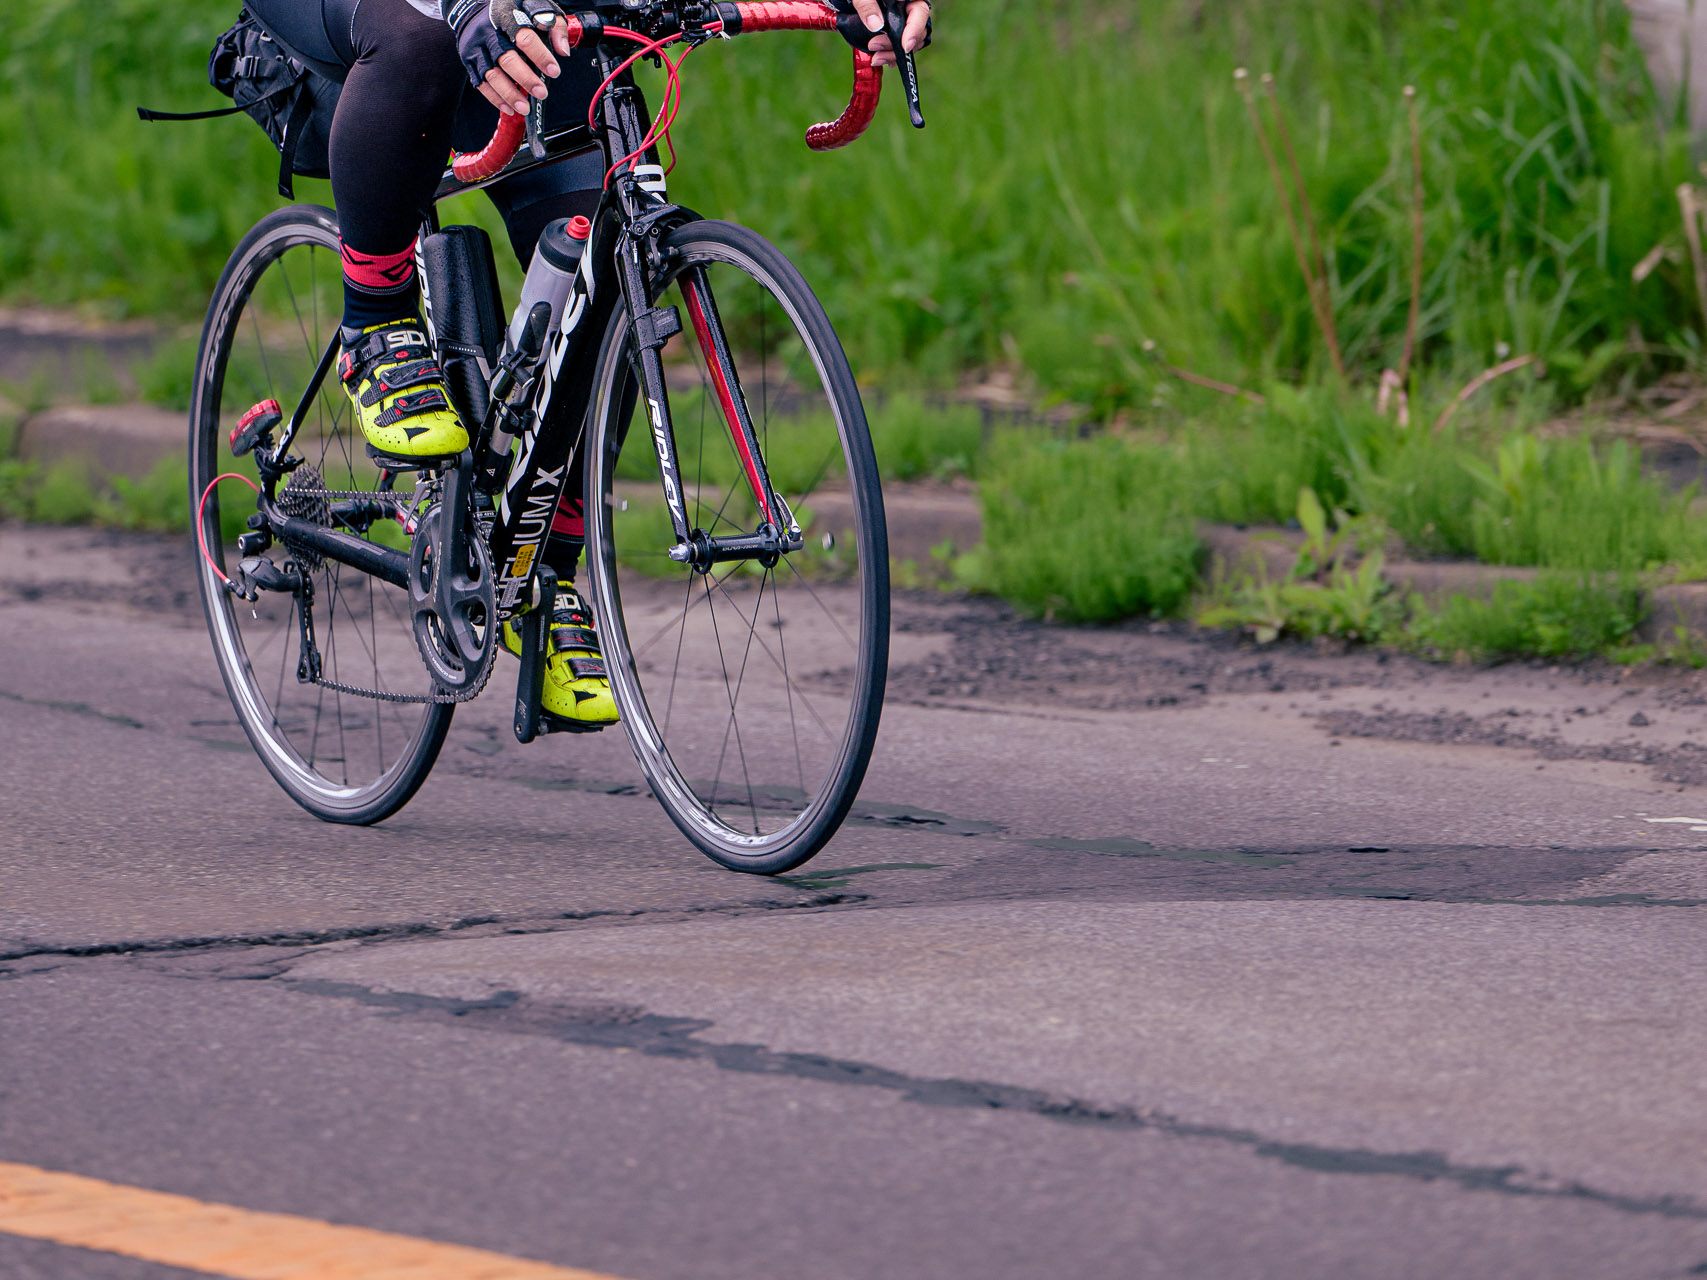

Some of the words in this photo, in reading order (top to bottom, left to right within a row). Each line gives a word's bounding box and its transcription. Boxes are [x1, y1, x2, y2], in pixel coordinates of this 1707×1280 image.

[905, 52, 919, 103] TEGRA
[387, 330, 428, 349] SIDI
[531, 464, 565, 491] X
[648, 397, 683, 523] RIDLEY
